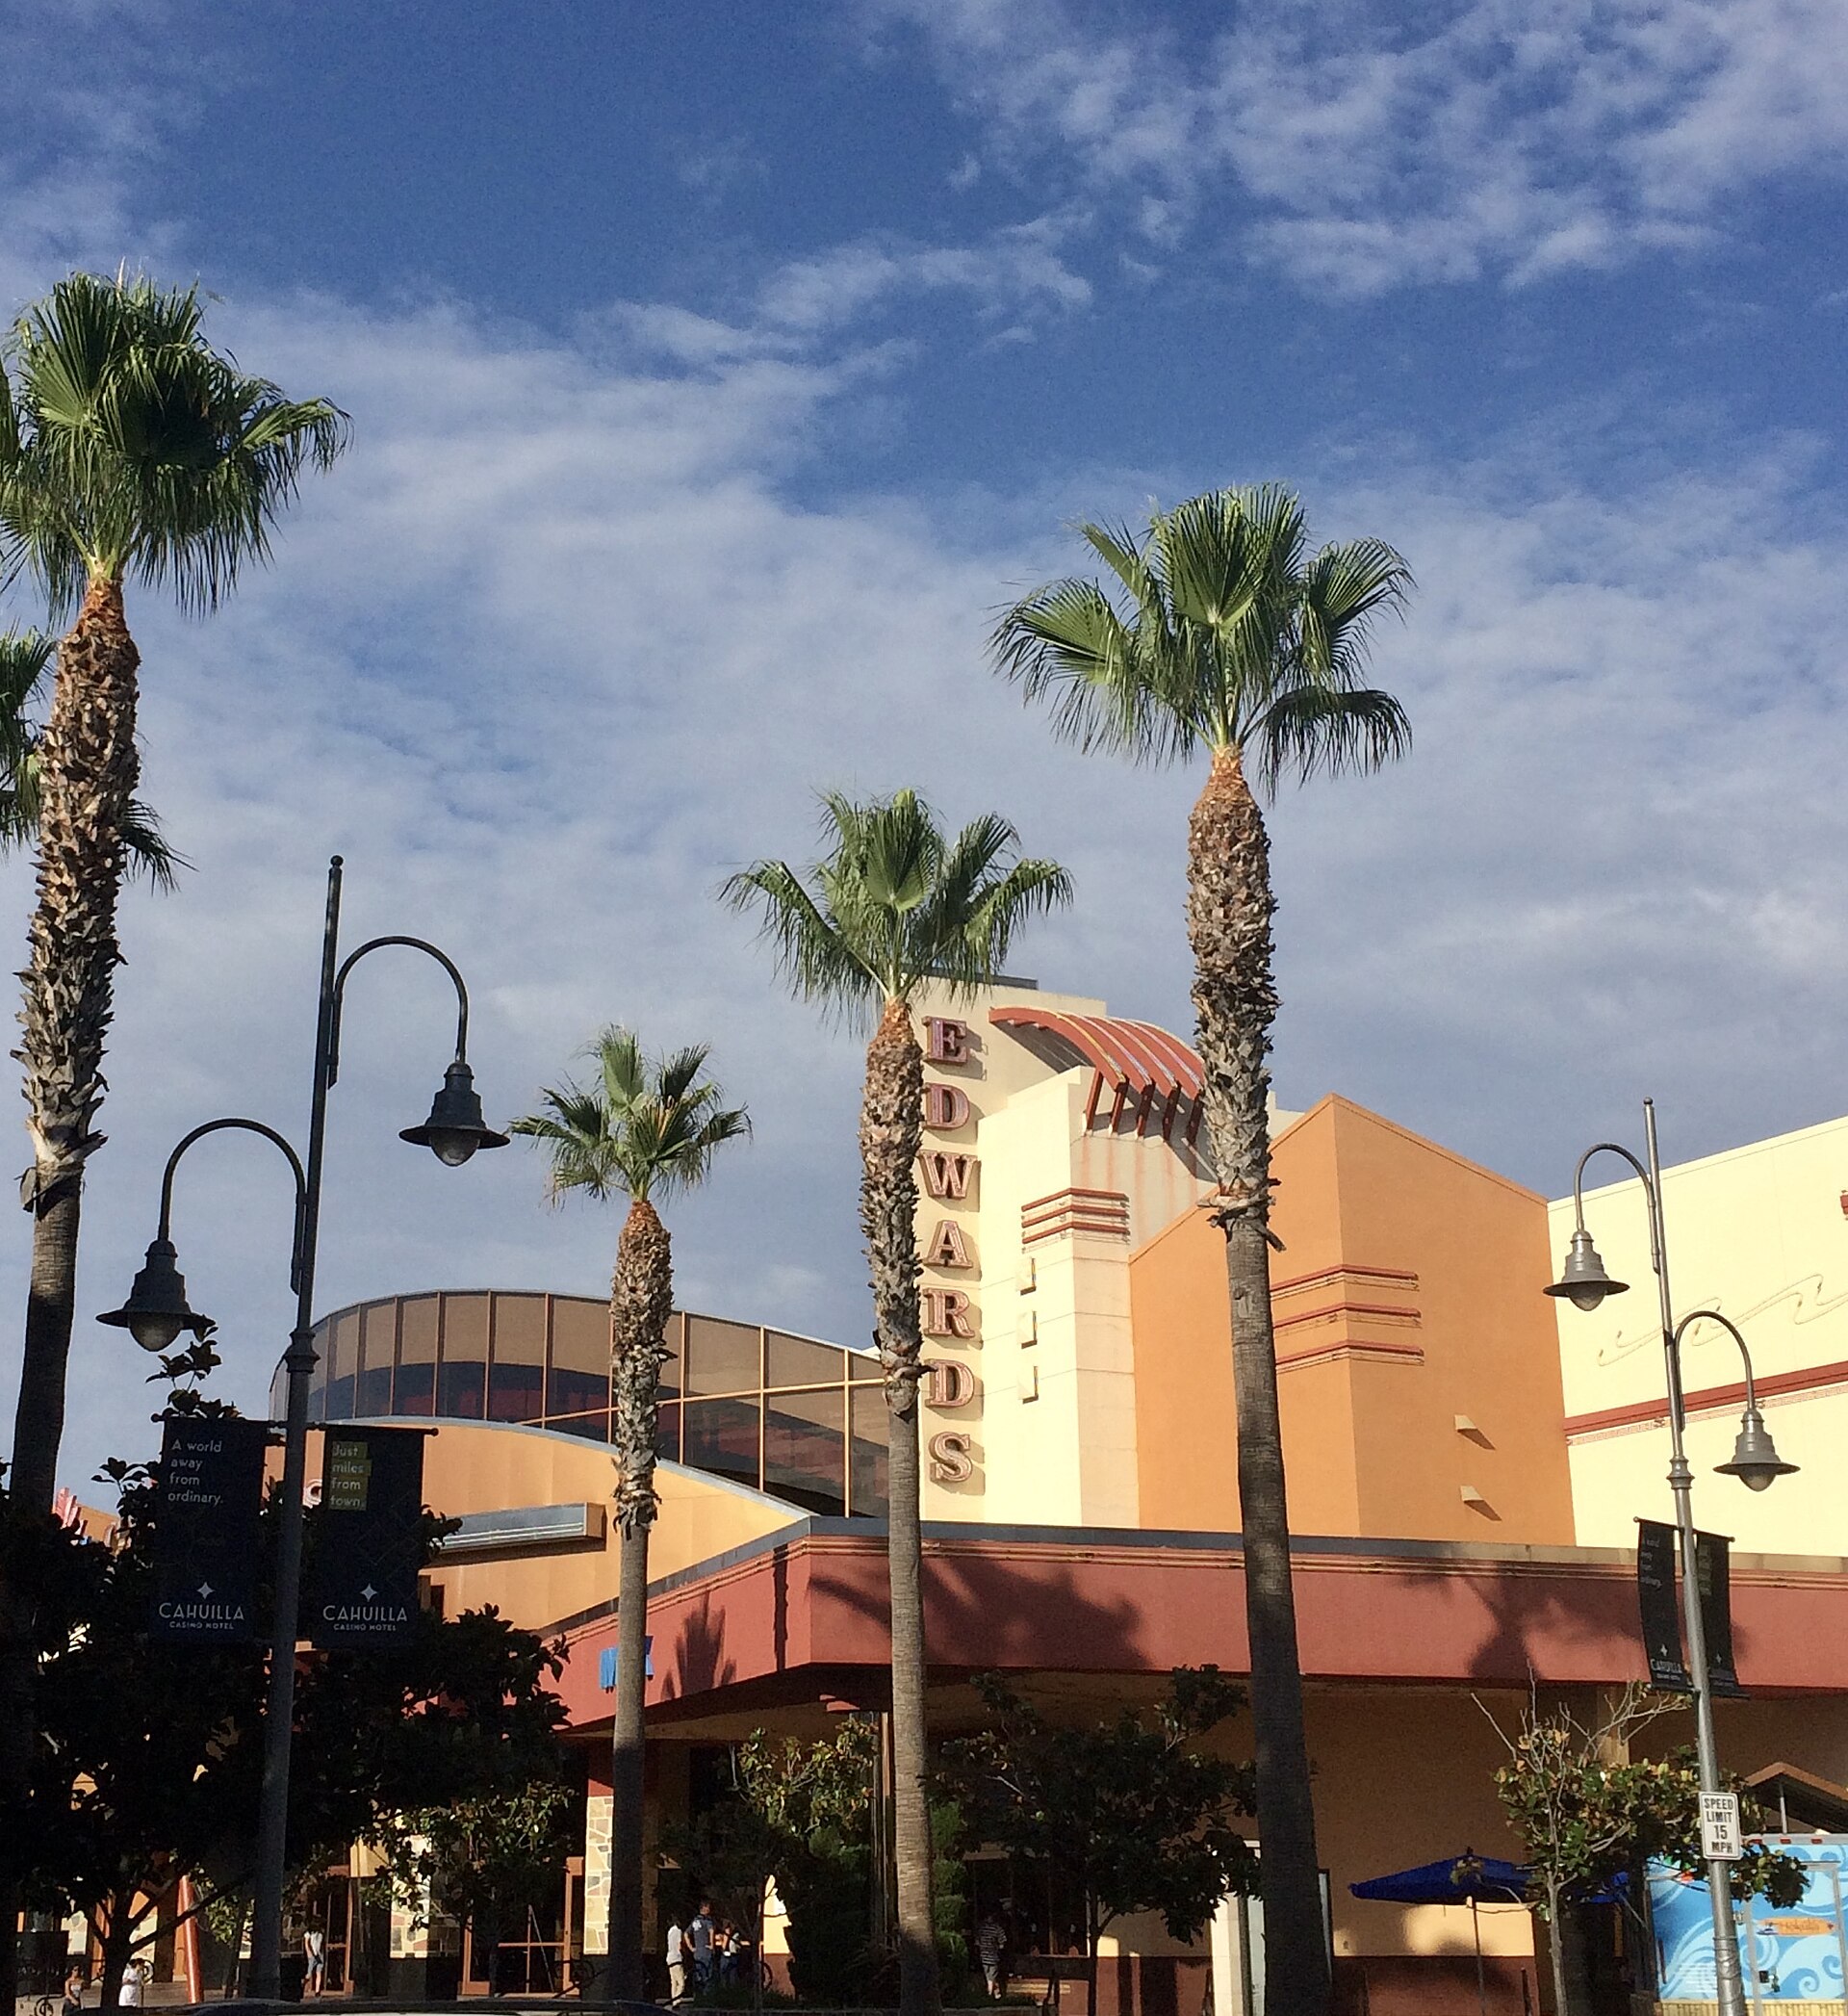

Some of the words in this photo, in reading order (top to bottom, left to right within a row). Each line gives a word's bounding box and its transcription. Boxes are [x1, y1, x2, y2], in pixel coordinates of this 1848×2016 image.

[919, 1016, 977, 1484] EDWARDS
[172, 1438, 182, 1451] A
[187, 1439, 222, 1453] world
[332, 1444, 359, 1457] Just
[170, 1459, 203, 1472] away
[332, 1460, 364, 1473] miles
[169, 1471, 200, 1486] from
[331, 1477, 361, 1489] from
[167, 1488, 224, 1508] ordinary.
[159, 1602, 244, 1620] CAHUILLA
[322, 1605, 408, 1622] CAHUILLA
[169, 1620, 203, 1629] CASINO
[1704, 1797, 1733, 1810] SPEED
[1707, 1811, 1732, 1823] LIMIT
[1714, 1824, 1728, 1840] 15
[1711, 1841, 1732, 1854] MPH
